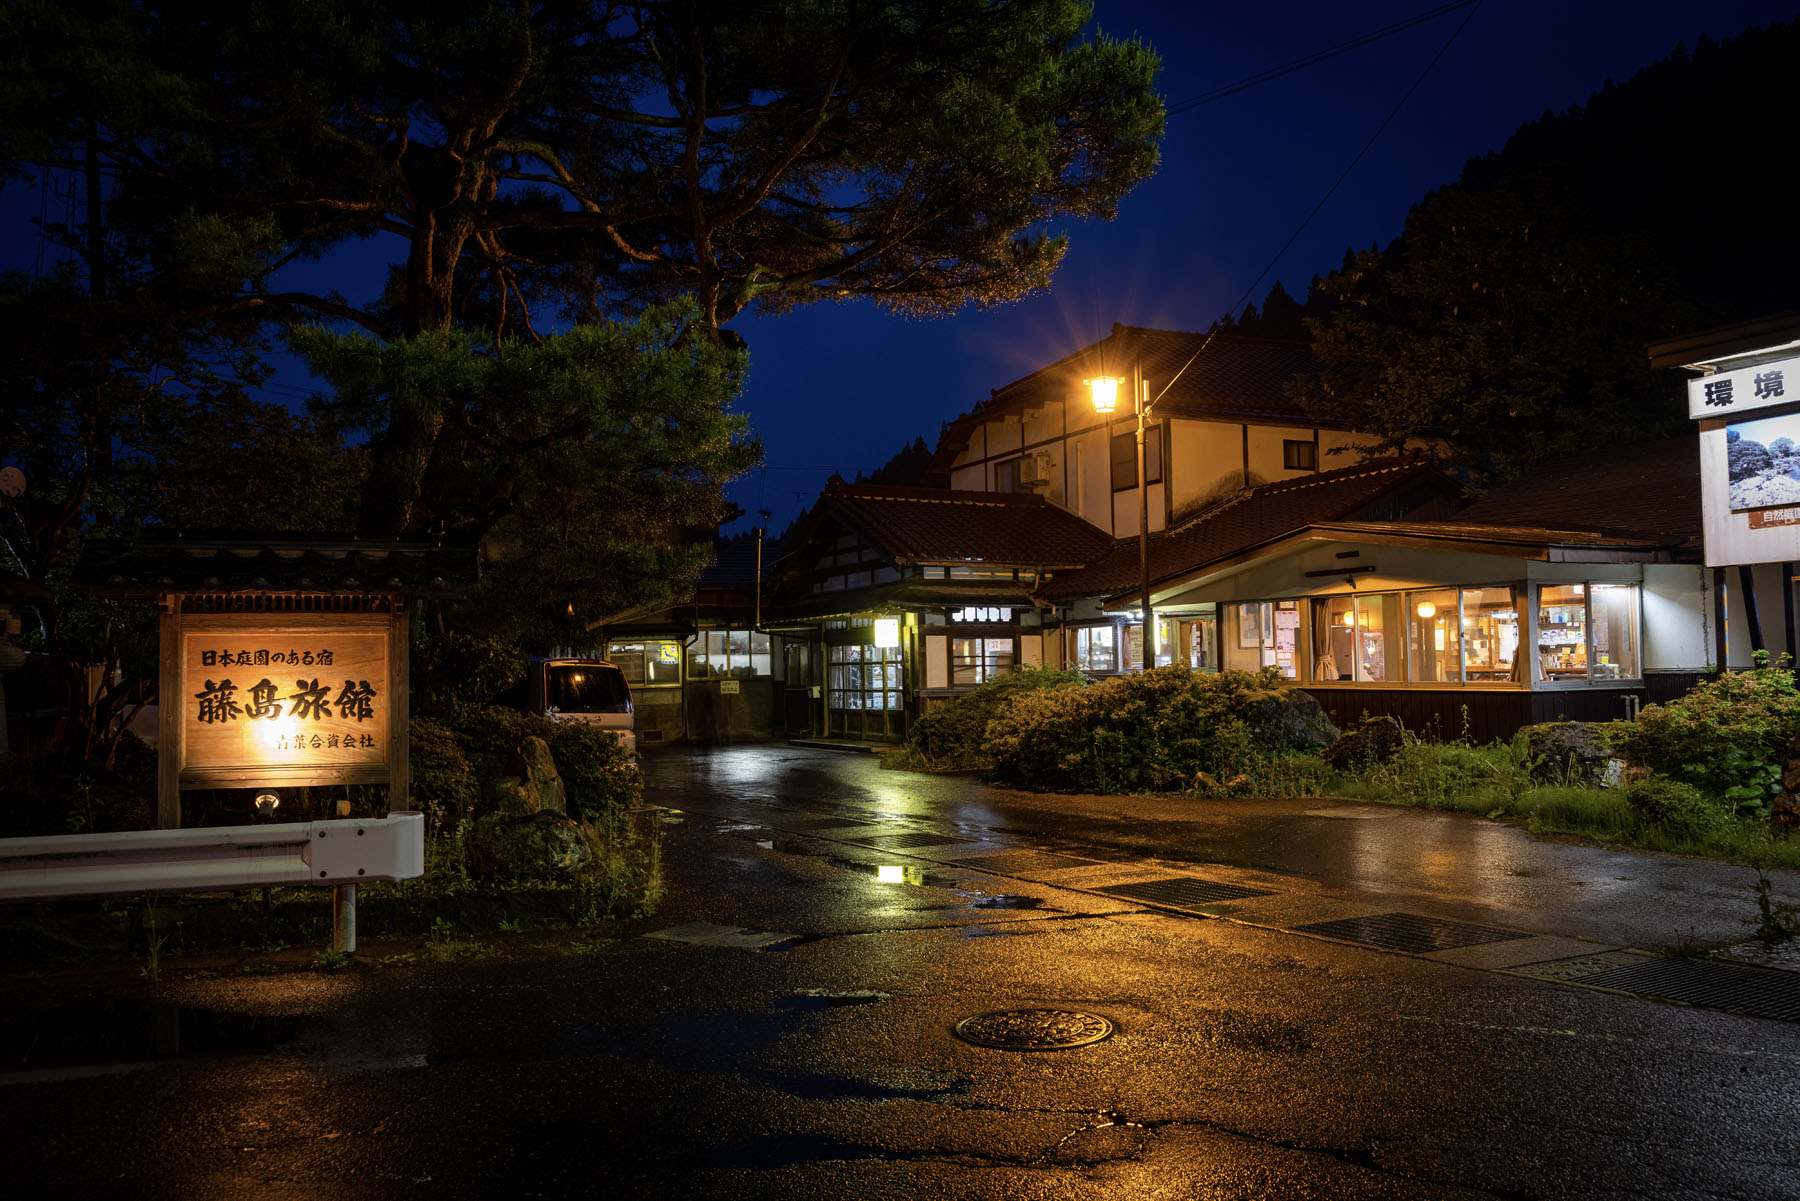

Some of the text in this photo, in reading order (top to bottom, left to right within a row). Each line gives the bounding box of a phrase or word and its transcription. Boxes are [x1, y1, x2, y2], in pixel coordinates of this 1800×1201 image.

[202, 649, 334, 667] 日本庭園のある宿
[194, 677, 377, 724] 藤島旅館
